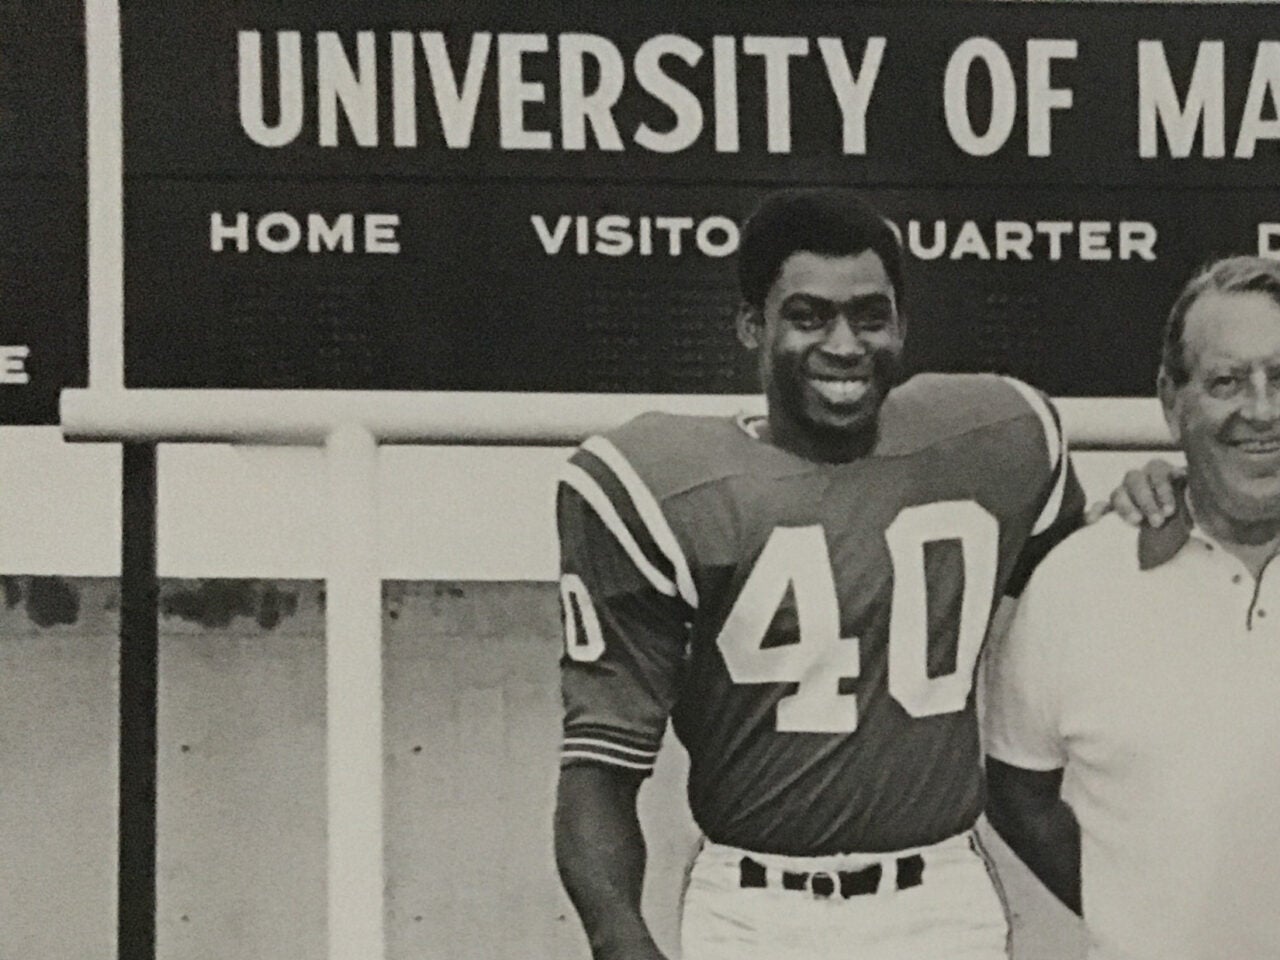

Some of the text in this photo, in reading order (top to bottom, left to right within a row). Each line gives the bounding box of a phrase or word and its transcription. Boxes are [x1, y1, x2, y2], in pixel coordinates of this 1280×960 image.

[237, 30, 887, 155] UNIVERSITY
[943, 36, 1078, 157] OF
[210, 211, 401, 254] HOME
[530, 214, 741, 257] VISITO
[882, 218, 1158, 261] UARTER
[716, 499, 1000, 733] 40
